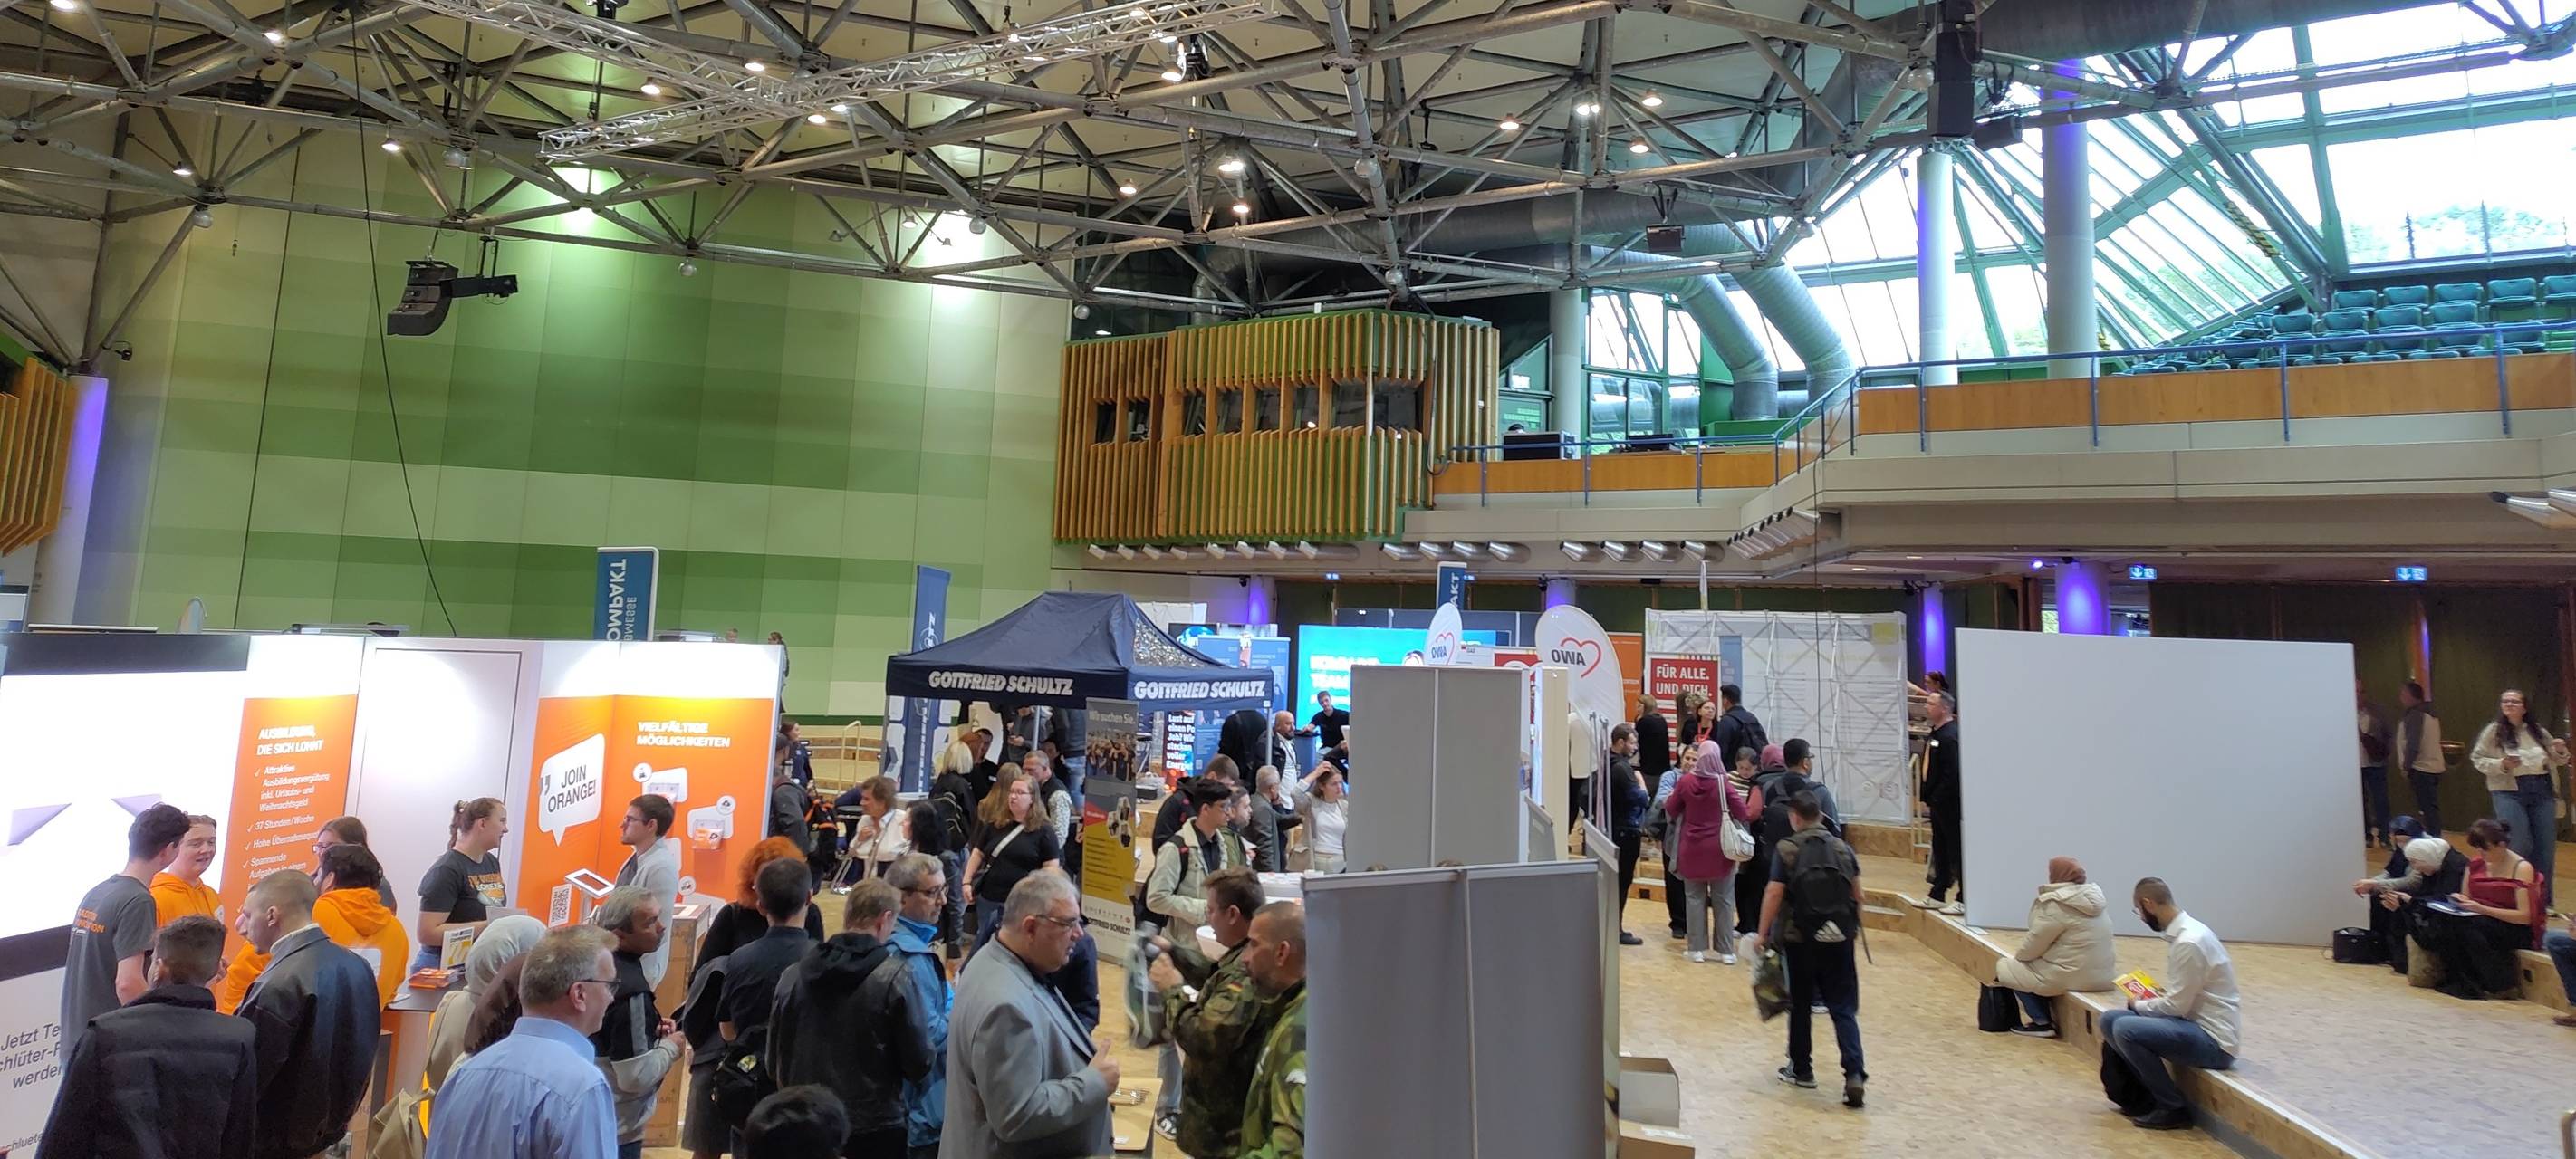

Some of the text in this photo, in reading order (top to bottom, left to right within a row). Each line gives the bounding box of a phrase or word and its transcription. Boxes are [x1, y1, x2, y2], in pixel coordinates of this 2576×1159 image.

[1432, 646, 1448, 659] OWA
[1552, 649, 1586, 666] OWA
[1656, 664, 1710, 680] FÜR ALLE.
[928, 671, 1073, 695] GOTTFRIED SCHULTZ
[1134, 680, 1266, 700] GOTTFRIED SCHULTZ
[1656, 683, 1713, 697] UND DICH.
[1168, 714, 1183, 723] Lust
[638, 721, 708, 733] VIELFÄLTIGE
[1168, 723, 1187, 733] einen
[637, 735, 730, 747] MÖGLICHKEITEN
[1168, 733, 1183, 742] Job?
[256, 739, 323, 755] DIE SICH LOHNT
[1167, 742, 1192, 751] stecken
[1166, 751, 1187, 760] voller
[264, 764, 295, 774] Attraktive
[561, 765, 586, 788] JOIN
[548, 780, 596, 812] ORANGE!
[259, 799, 309, 811] Weihnachtsgeld
[255, 820, 264, 829] 37
[253, 832, 319, 849] Hohe Übernahmequo
[250, 854, 287, 867] Spannende
[1088, 917, 1110, 929] OTTFRIED
[1, 1023, 61, 1051] Jetzt Te
[0, 1042, 61, 1072] chlüter-
